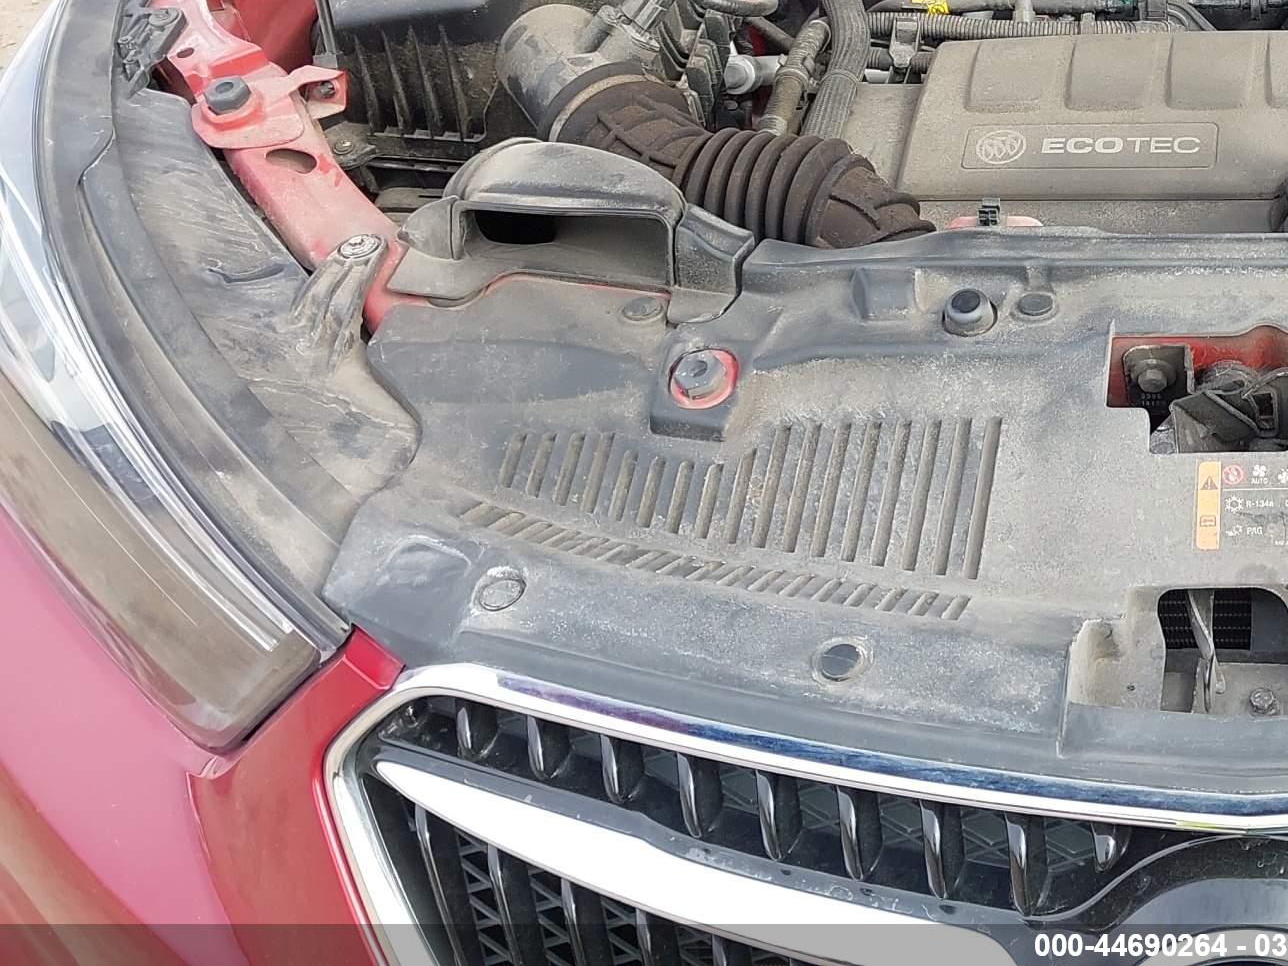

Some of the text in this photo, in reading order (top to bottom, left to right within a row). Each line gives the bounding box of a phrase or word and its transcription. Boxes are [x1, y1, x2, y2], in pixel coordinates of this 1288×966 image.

[1041, 137, 1201, 154] ECOTEC
[1246, 499, 1274, 507] R-134a
[1246, 527, 1263, 535] PAG
